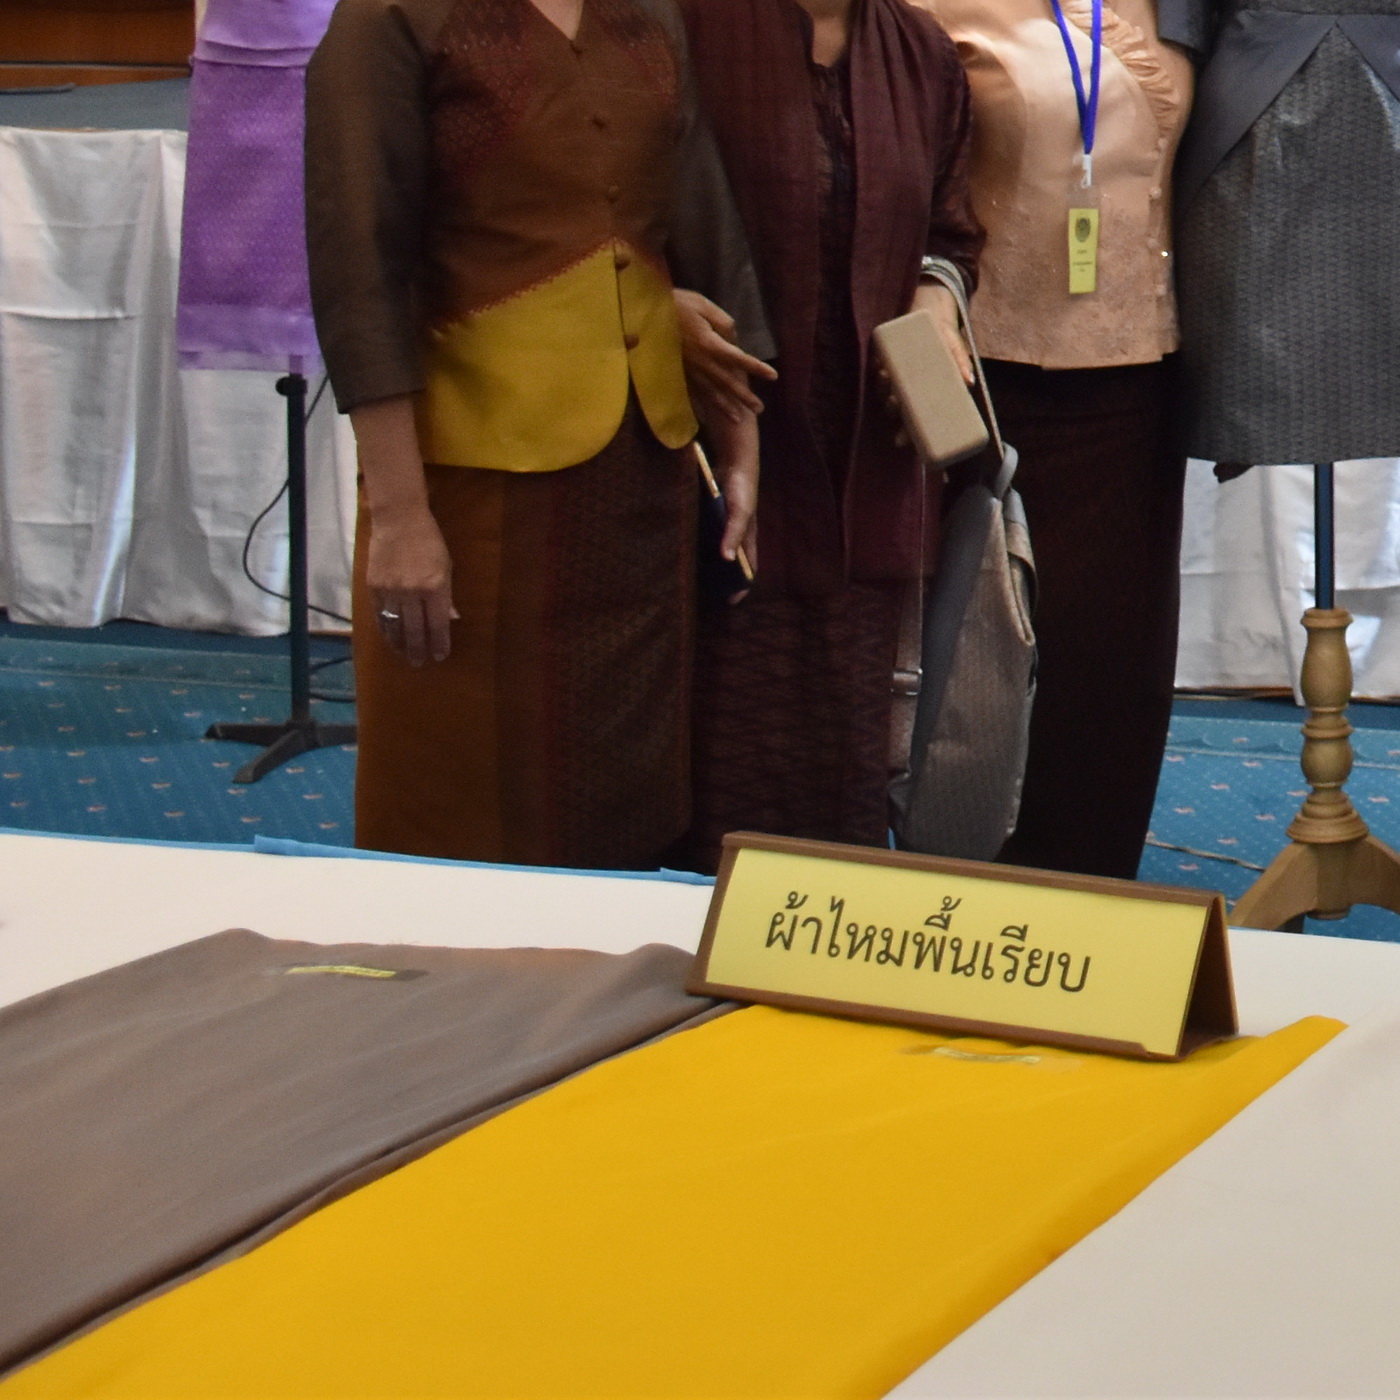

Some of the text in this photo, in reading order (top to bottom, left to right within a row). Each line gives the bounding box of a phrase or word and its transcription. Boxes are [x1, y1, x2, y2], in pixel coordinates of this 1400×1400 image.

[764, 891, 1091, 993] ผ้าไหมพื้นเรียบ
